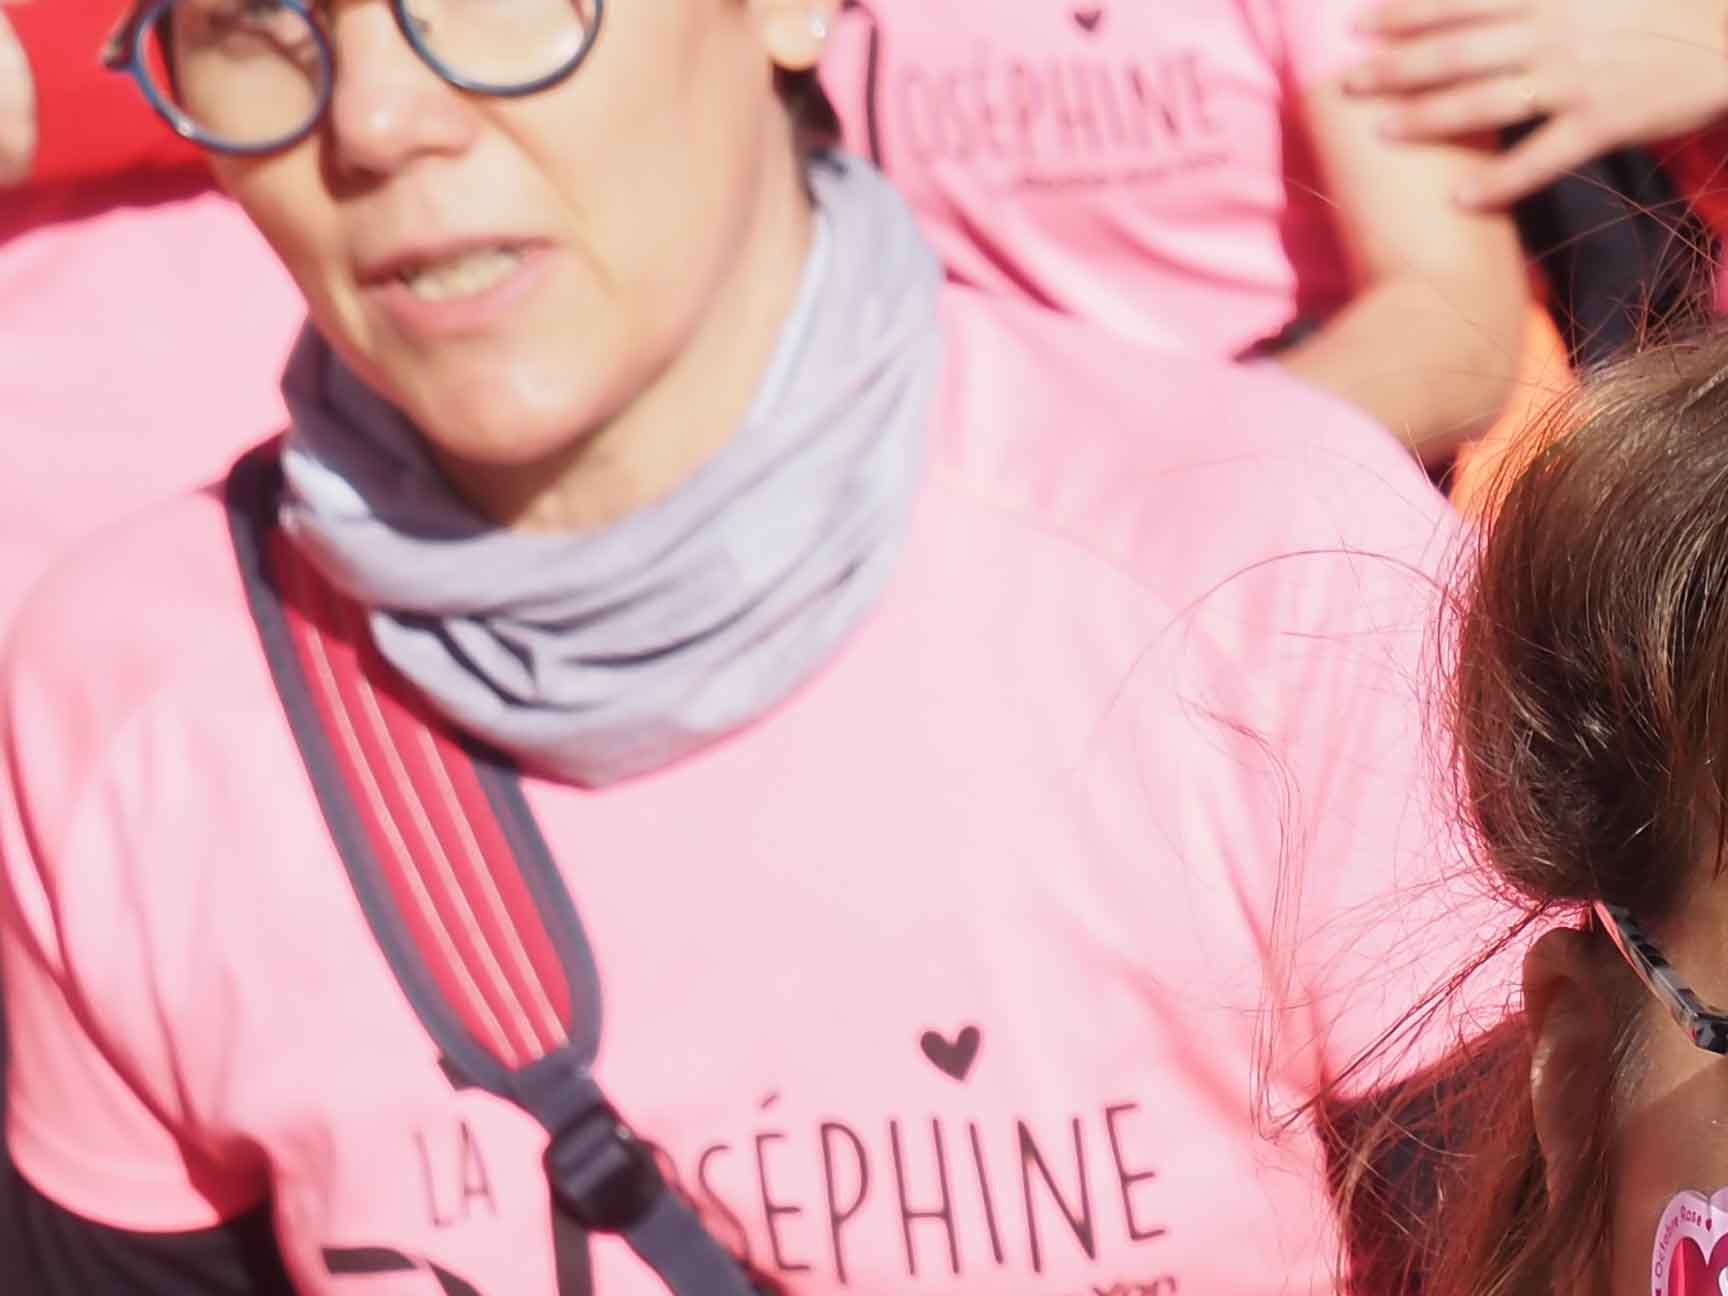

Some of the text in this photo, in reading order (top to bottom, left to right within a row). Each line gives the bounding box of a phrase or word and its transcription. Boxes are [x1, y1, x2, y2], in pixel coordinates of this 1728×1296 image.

[898, 40, 1224, 166] OSÉPHINE
[413, 1092, 1168, 1286] LA SÉPHINE
